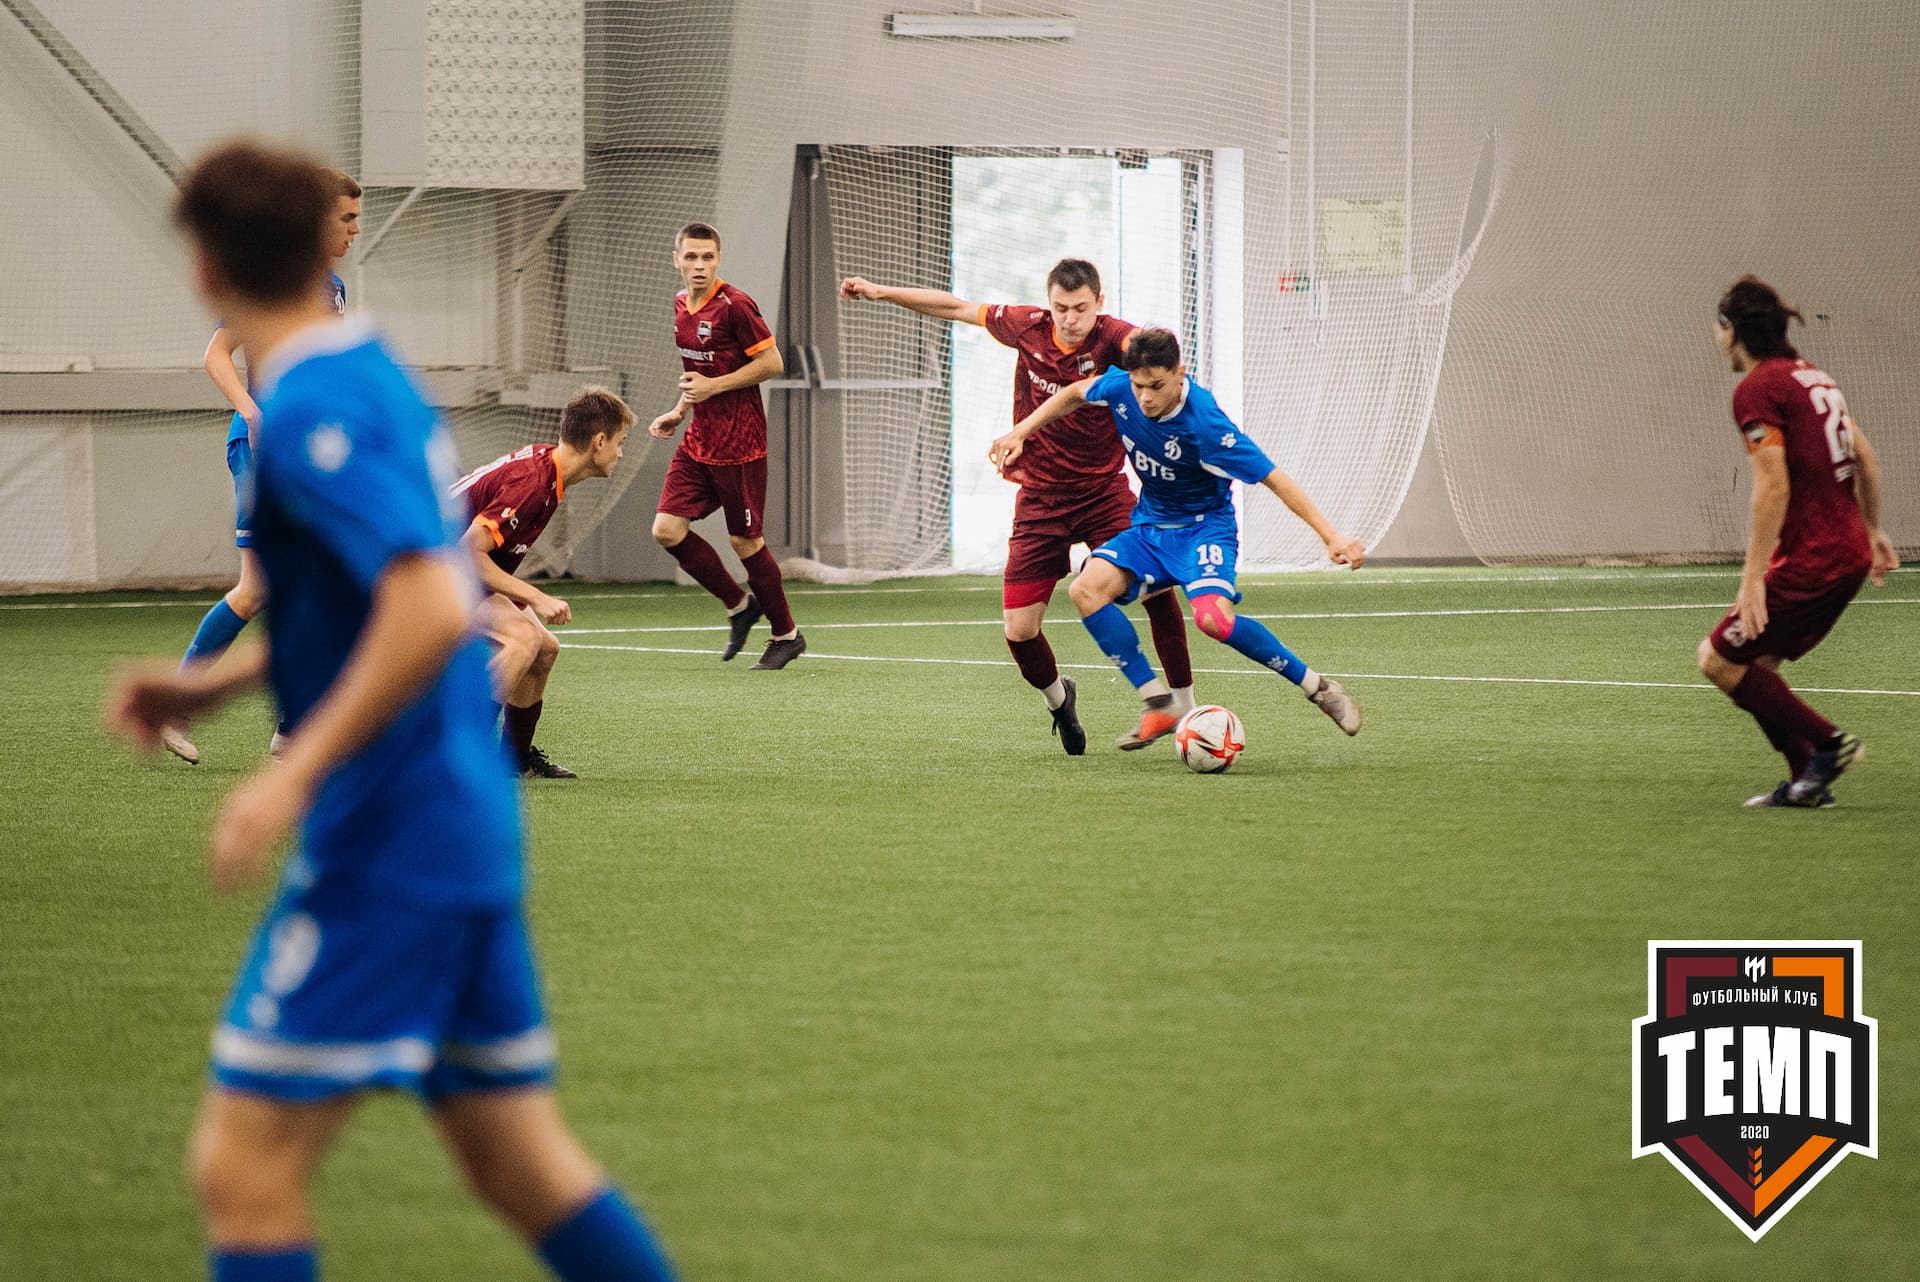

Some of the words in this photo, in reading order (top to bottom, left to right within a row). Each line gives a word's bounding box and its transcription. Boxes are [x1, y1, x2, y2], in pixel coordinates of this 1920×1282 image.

[1135, 450, 1176, 481] ВТБ
[745, 508, 752, 527] 9
[1196, 544, 1224, 565] 18
